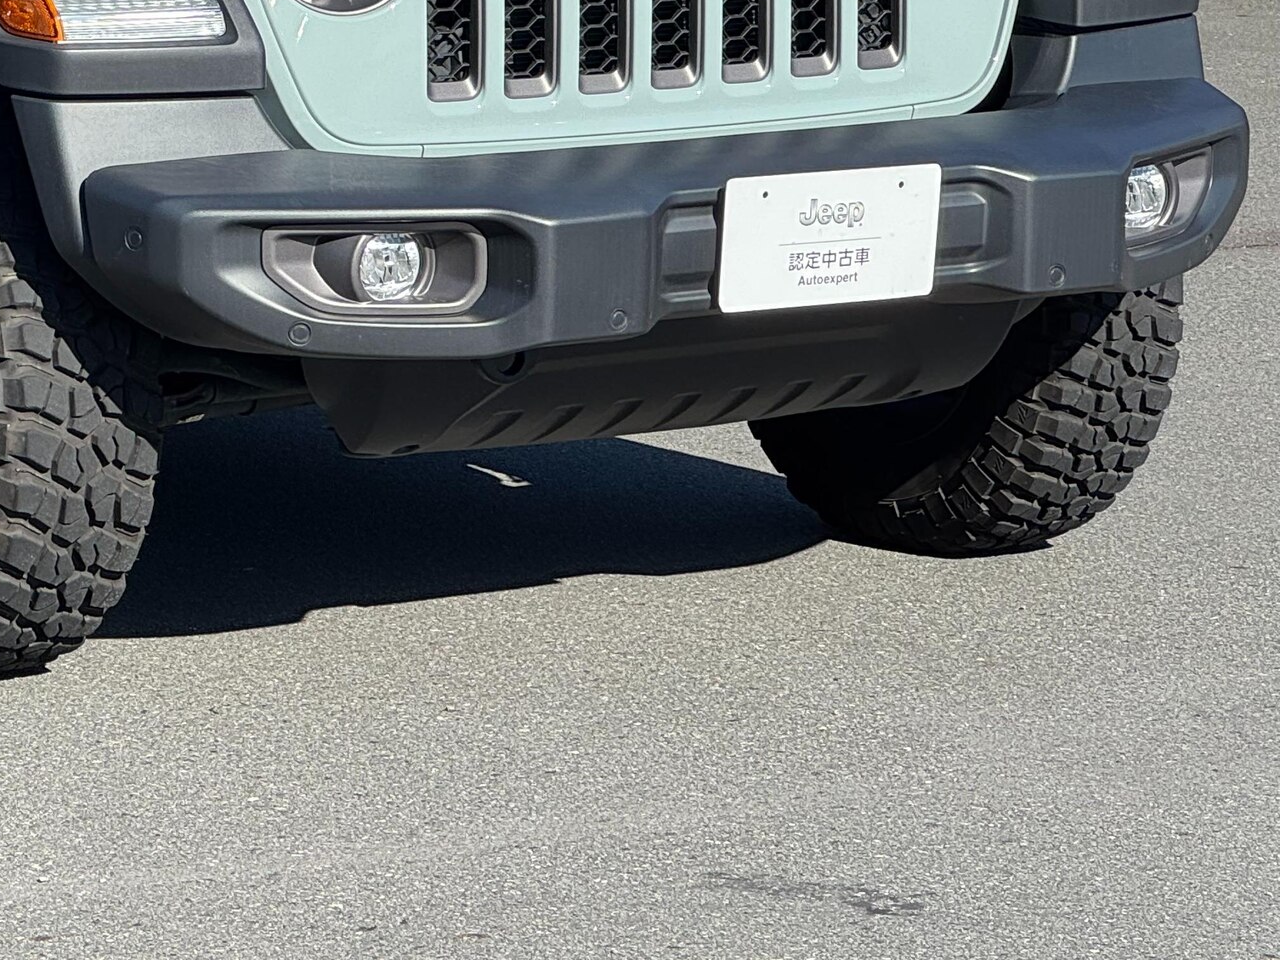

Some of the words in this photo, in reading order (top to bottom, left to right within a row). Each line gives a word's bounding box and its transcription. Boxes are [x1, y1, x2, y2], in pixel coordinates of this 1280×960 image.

[799, 198, 865, 228] Jeep
[788, 247, 871, 272] 認定中古車
[798, 272, 858, 286] Autoexpert
